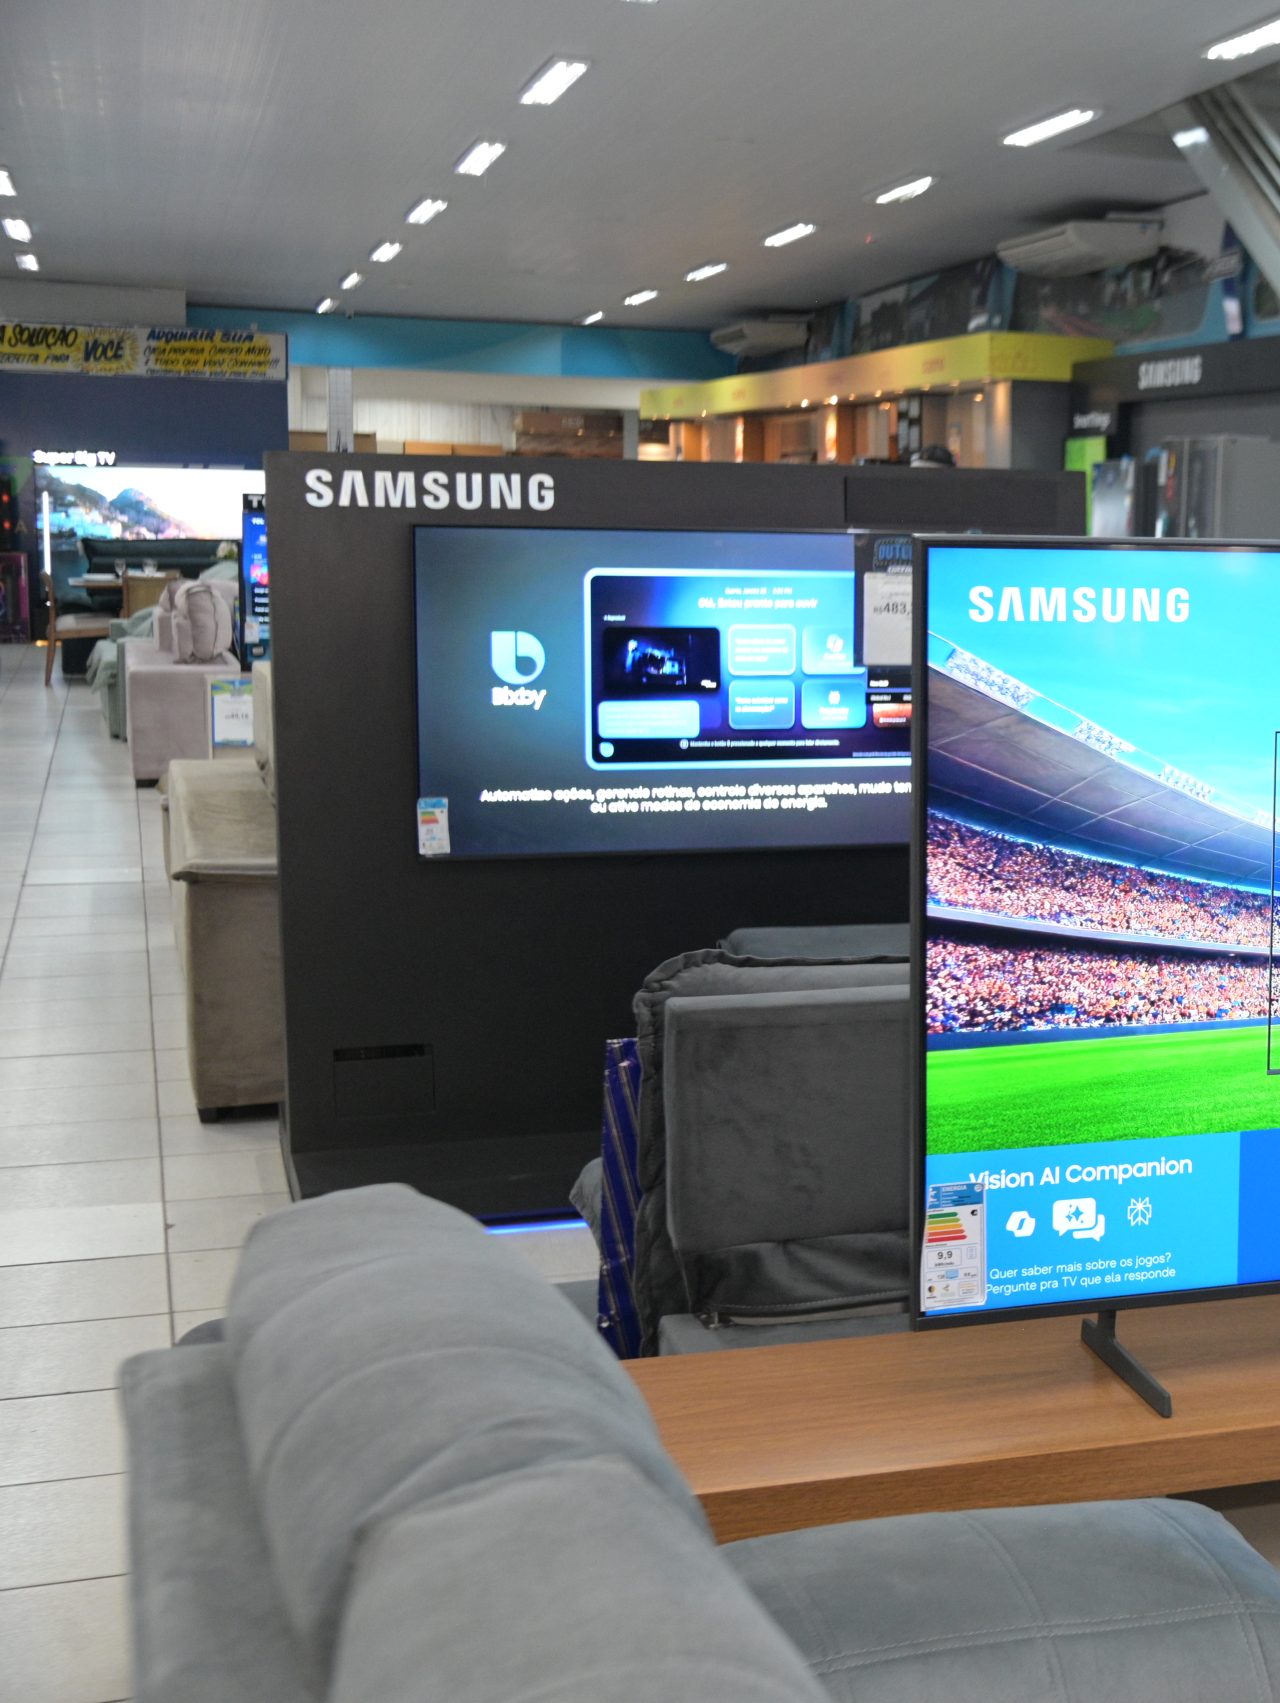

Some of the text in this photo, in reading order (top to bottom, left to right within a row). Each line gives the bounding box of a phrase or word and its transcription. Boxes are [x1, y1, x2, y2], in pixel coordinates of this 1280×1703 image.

[1138, 354, 1202, 390] SAMSUNG
[97, 451, 116, 466] TV
[305, 468, 556, 512] SAMSUNG
[968, 585, 1190, 623] SAMSUNG
[491, 686, 547, 710] Bixby
[480, 788, 552, 802] Automatize
[697, 784, 746, 798] controle
[748, 783, 796, 796] diversos
[858, 781, 893, 795] mude
[590, 801, 607, 814] ou
[608, 799, 639, 813] ative
[640, 799, 683, 813] modos
[684, 799, 700, 811] de
[702, 797, 761, 811] economia
[763, 797, 779, 810] de
[969, 1156, 1193, 1190] Vision AI Companion
[937, 1250, 953, 1261] 9,9
[990, 1267, 1017, 1281] Quer
[1021, 1263, 1052, 1277] saber
[1056, 1260, 1083, 1274] mais
[1085, 1257, 1116, 1271] sobre
[1120, 1257, 1133, 1268] os
[1134, 1252, 1172, 1270] jogos?
[986, 1267, 1176, 1297] Pergunte pra TV que ela responde
